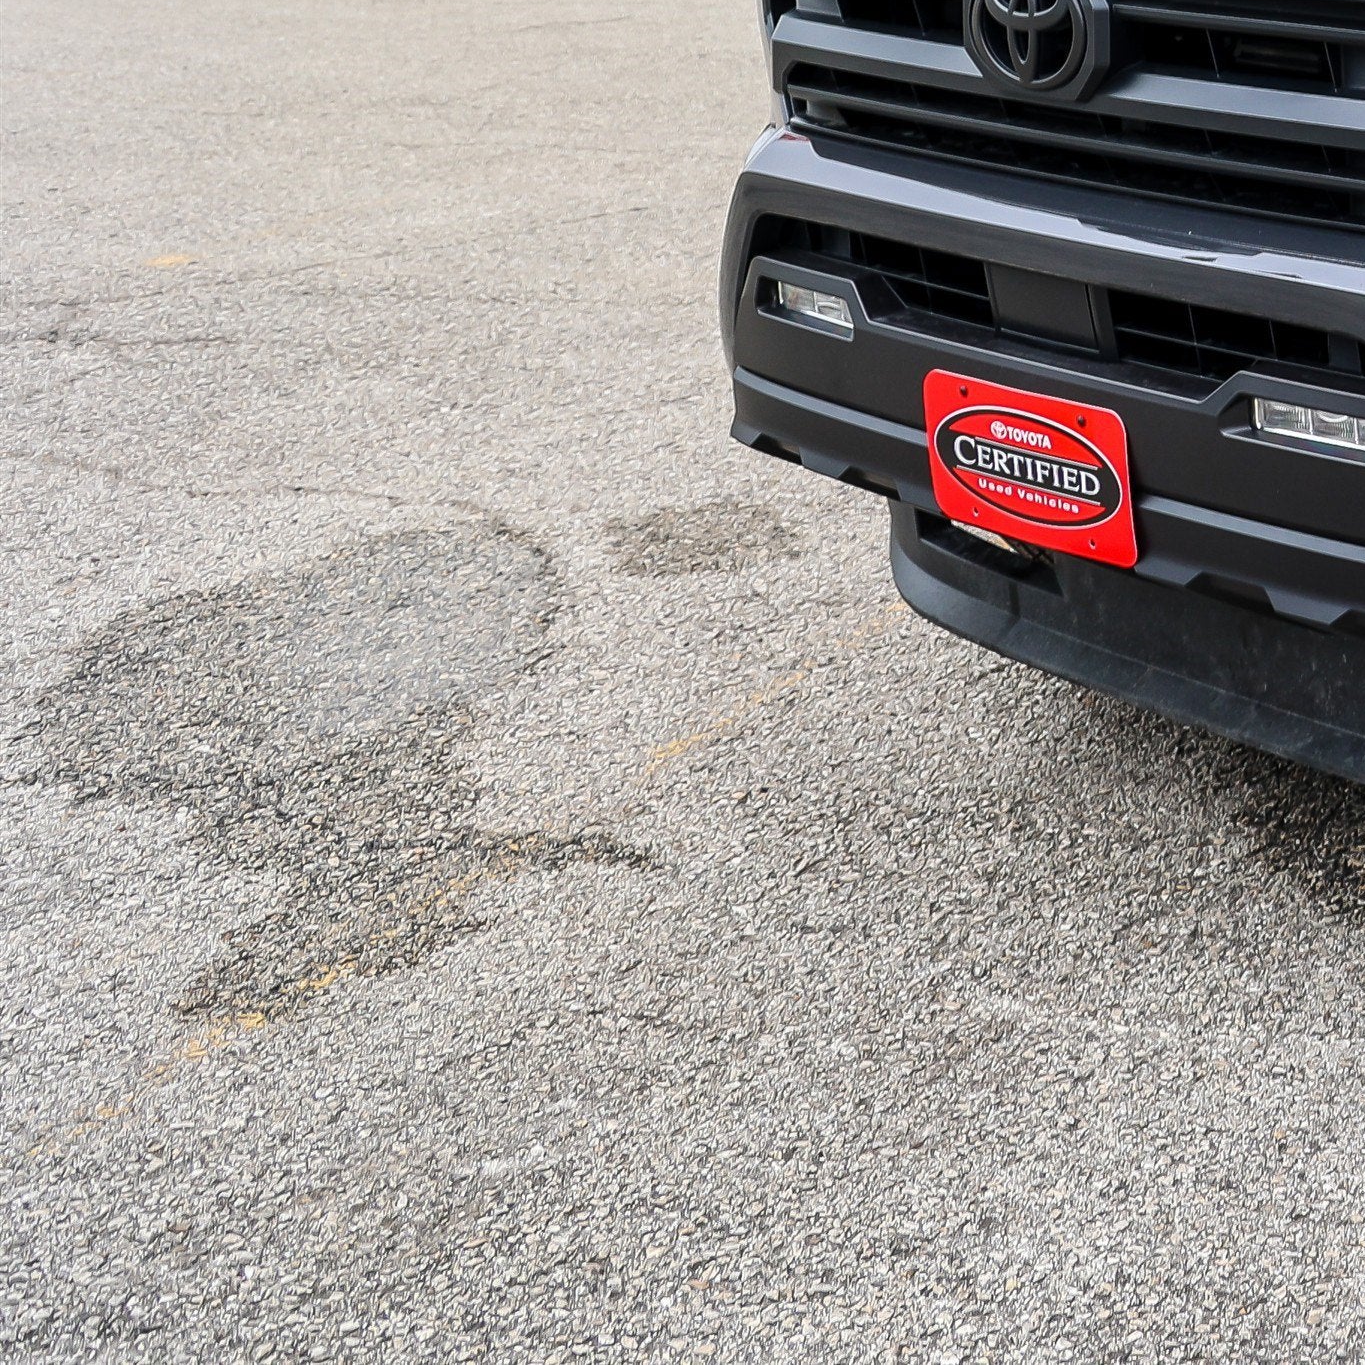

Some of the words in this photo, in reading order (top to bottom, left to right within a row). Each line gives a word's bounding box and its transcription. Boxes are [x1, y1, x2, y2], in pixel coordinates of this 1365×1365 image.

[1006, 426, 1052, 450] TOYOTA
[953, 436, 1100, 496] CERTIFIED
[977, 477, 1013, 496] Used
[1017, 487, 1080, 514] Vehicles
